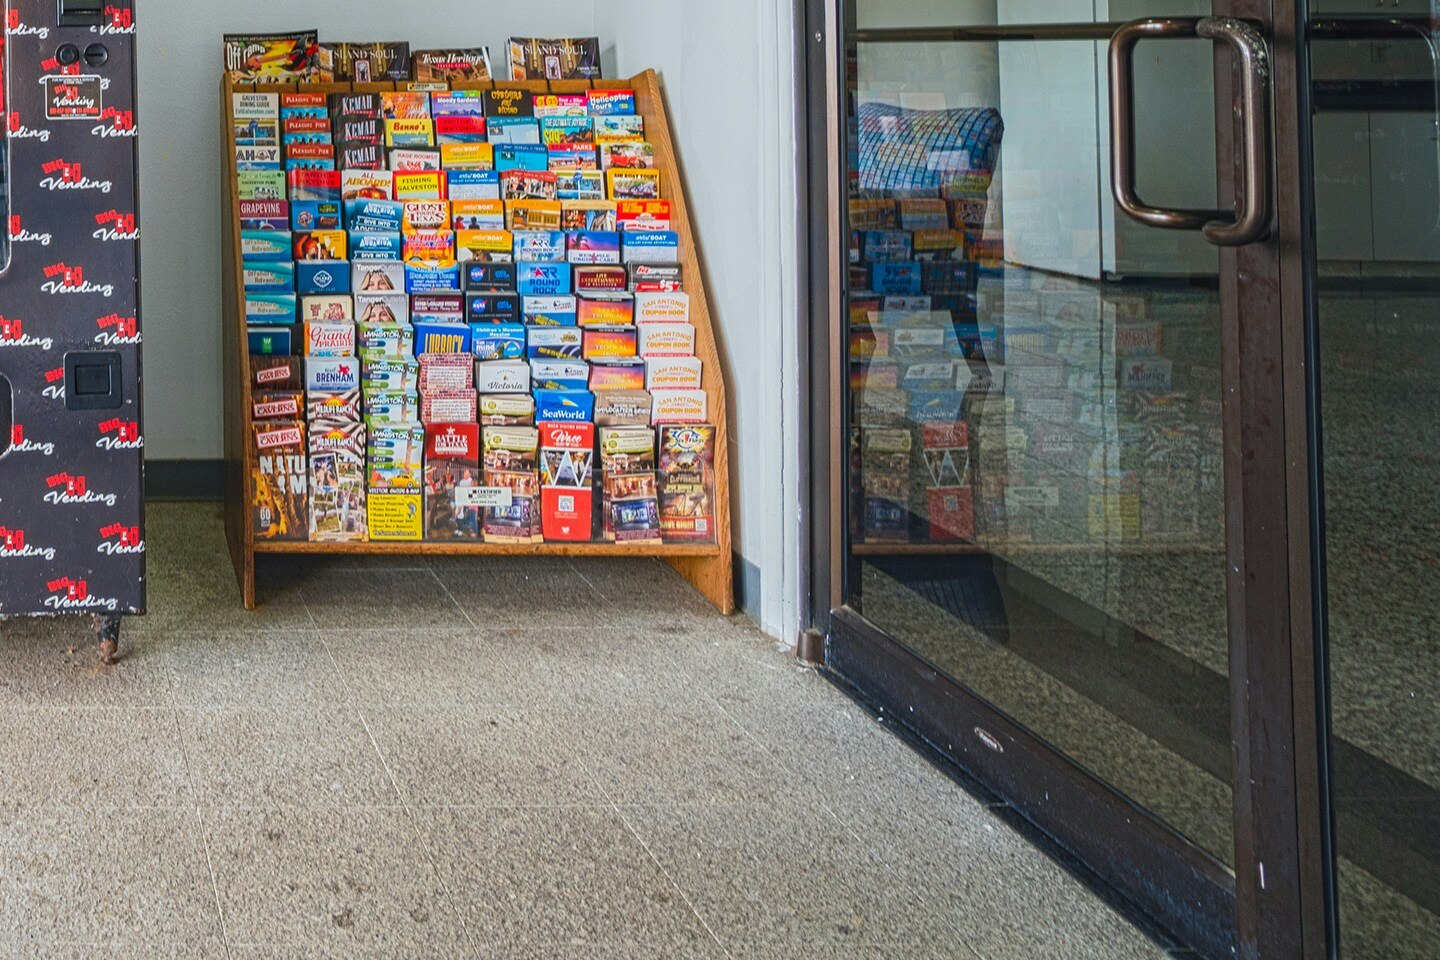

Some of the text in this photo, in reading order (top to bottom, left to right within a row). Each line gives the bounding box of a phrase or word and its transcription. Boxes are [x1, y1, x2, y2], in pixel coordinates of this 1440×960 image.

[369, 48, 398, 60] SOUL
[558, 45, 587, 55] SOUL
[226, 42, 241, 71] Off
[422, 52, 484, 66] Texas Heritage
[342, 95, 372, 112] KEMAH
[589, 94, 630, 104] Helicopter
[345, 120, 375, 137] KEMAH
[393, 122, 426, 131] Benno's
[40, 176, 113, 193] Vending
[345, 176, 391, 187] ABOARD!
[240, 202, 281, 214] GRAPEVINE
[406, 202, 446, 211] GHOST
[409, 212, 446, 222] TEXAS
[41, 279, 114, 296] Vending
[530, 279, 560, 287] ROUND
[656, 299, 687, 308] ANTONIO
[310, 323, 353, 347] Grand
[646, 332, 692, 341] SAN ANTONIO
[319, 339, 353, 347] PRAIRIE
[407, 365, 416, 373] TX
[652, 366, 699, 376] SAN ANTONIO
[316, 371, 354, 383] BRENHAM
[487, 380, 524, 391] Victoria
[657, 398, 672, 407] SAN
[672, 396, 704, 406] ANTONIO
[257, 402, 296, 413] CAVERNS
[542, 408, 585, 420] SeaWorld
[260, 435, 299, 446] CAVERNS
[435, 434, 468, 442] BATTLE
[550, 430, 582, 443] Waco
[44, 489, 117, 507] Vending
[44, 593, 119, 611] Vending
